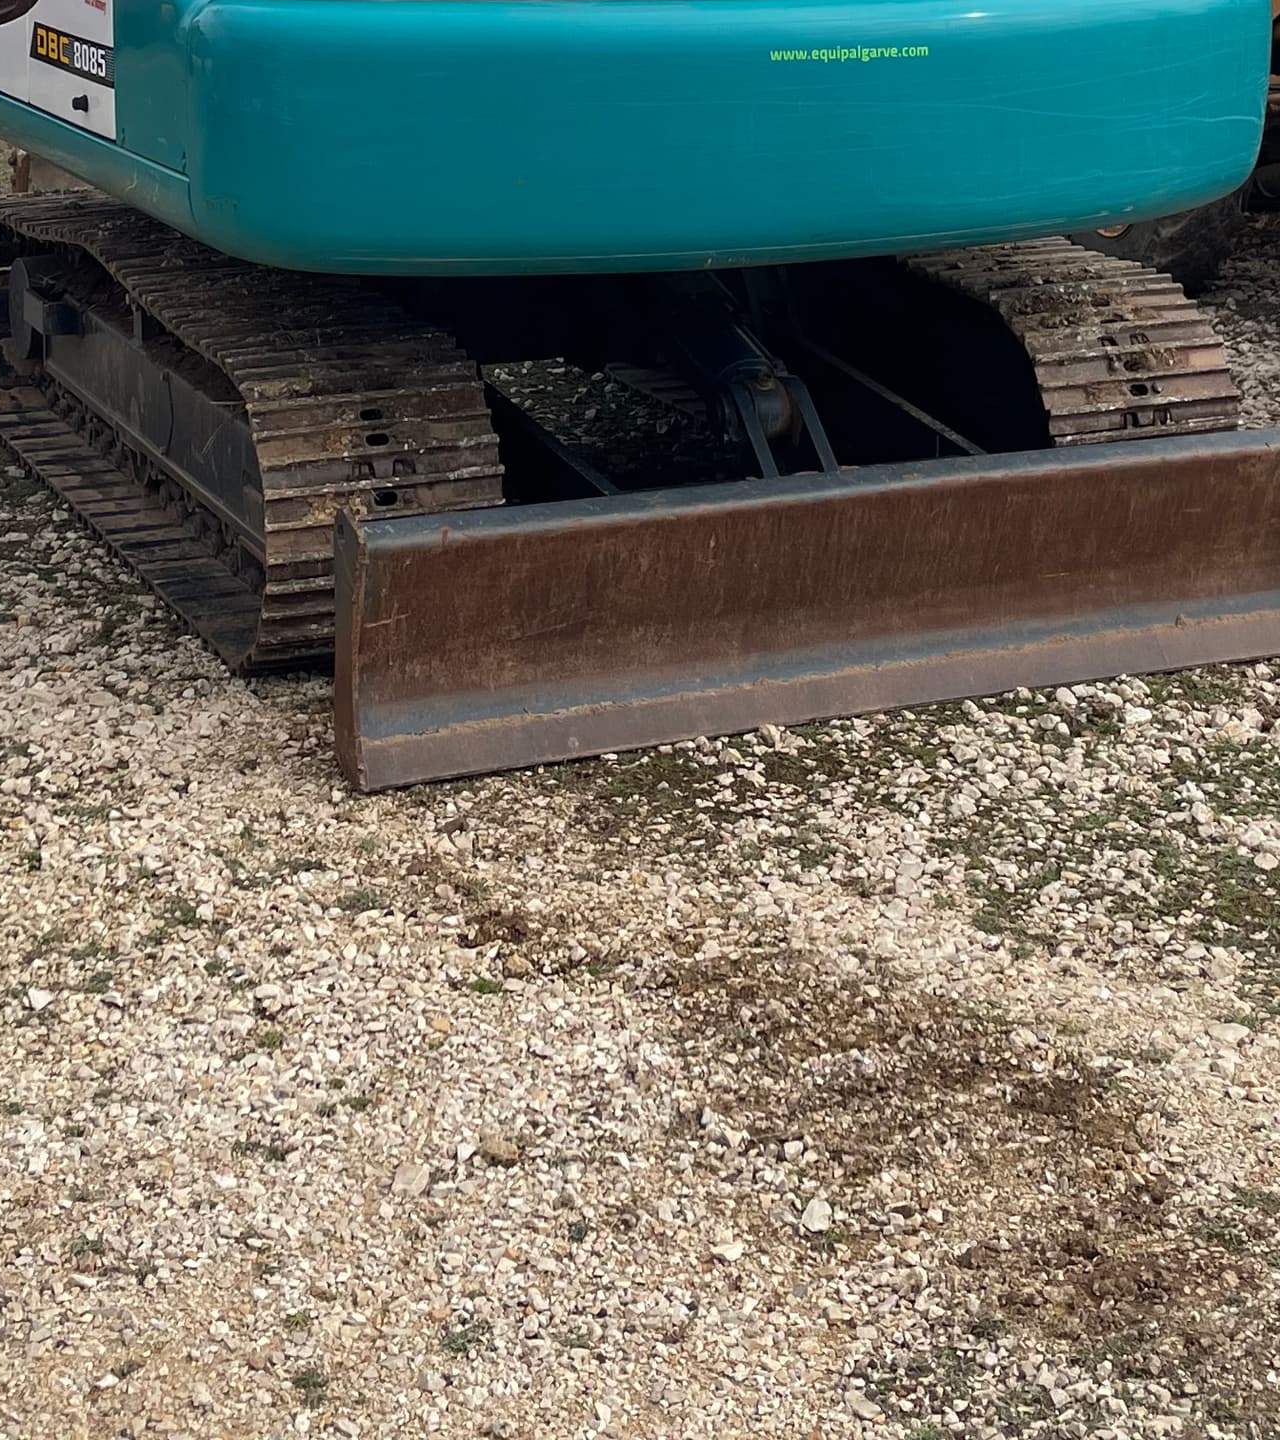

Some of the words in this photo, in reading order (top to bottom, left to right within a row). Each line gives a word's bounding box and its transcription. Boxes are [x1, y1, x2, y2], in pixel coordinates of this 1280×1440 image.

[37, 27, 69, 65] DBC
[73, 41, 106, 77] 8085
[770, 45, 929, 63] www.equipalgarve.com
